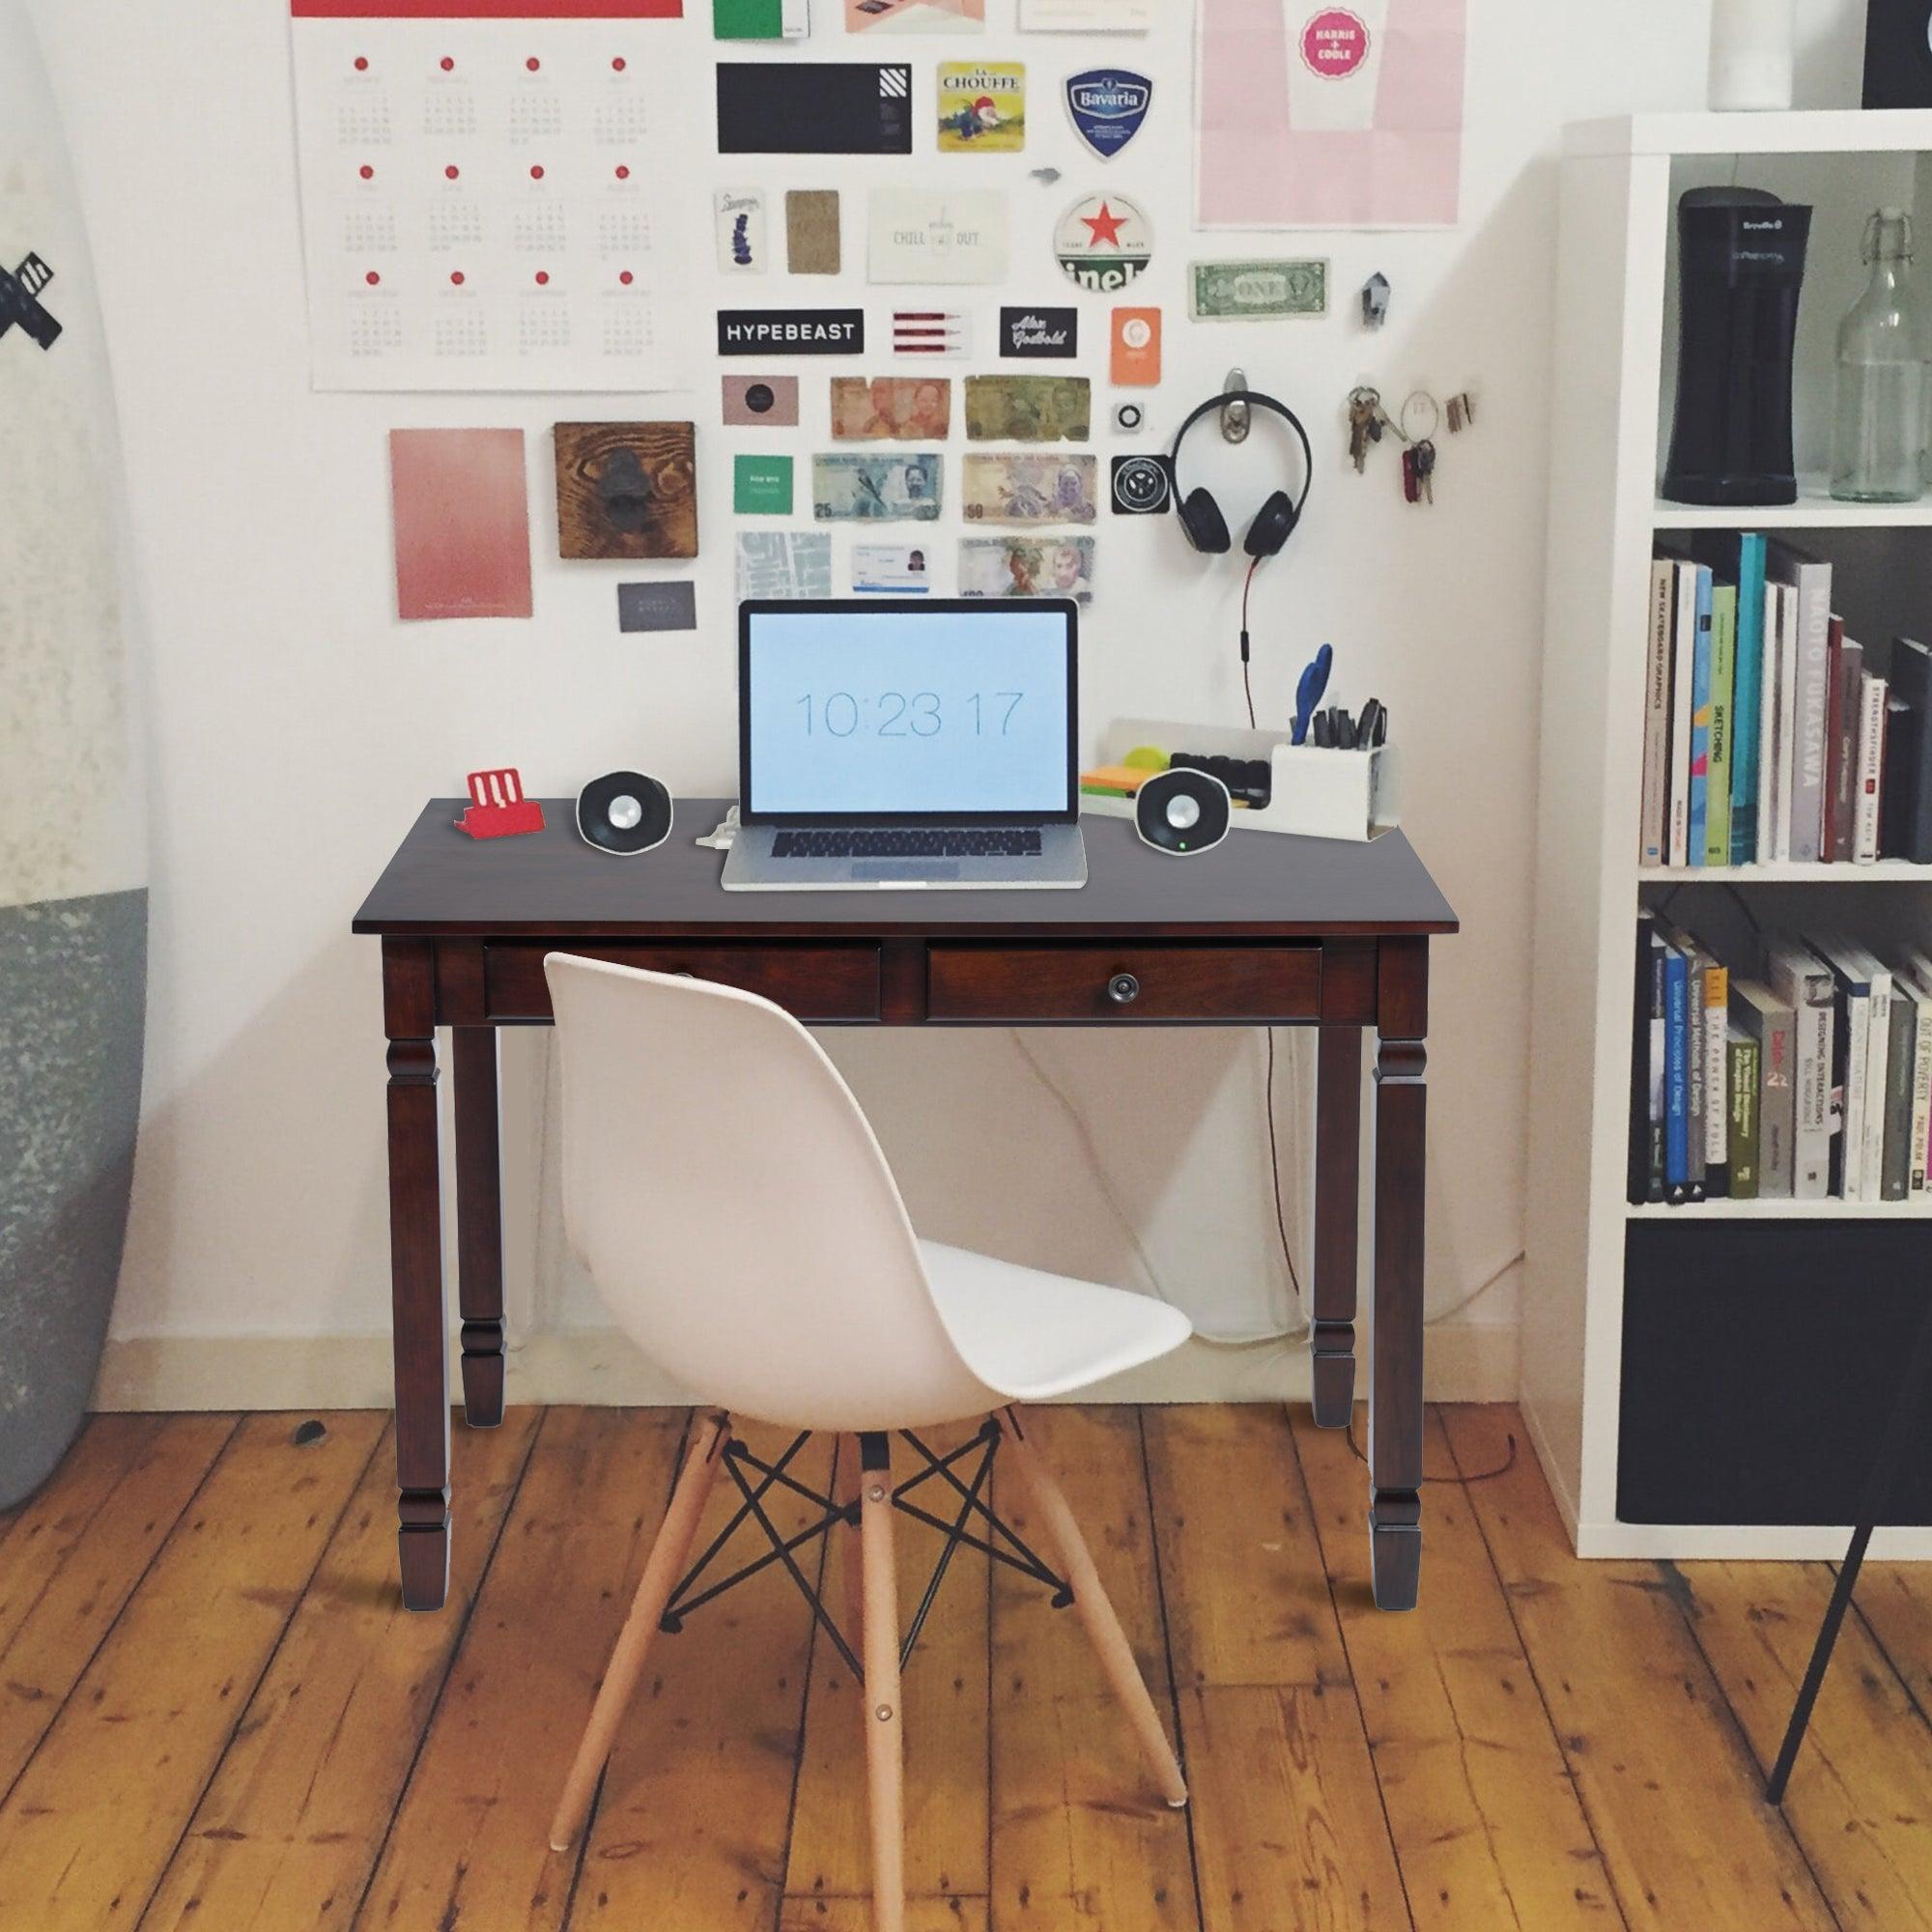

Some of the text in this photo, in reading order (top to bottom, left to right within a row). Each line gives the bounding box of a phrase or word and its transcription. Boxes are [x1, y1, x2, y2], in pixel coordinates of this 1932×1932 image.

[1316, 30, 1355, 41] HARRIS
[1318, 49, 1351, 59] COOLE
[944, 77, 1019, 89] CHOUFFE
[1080, 91, 1138, 106] Bavaria
[893, 231, 980, 245] CHILL OUT
[726, 324, 855, 341] HYPEBEAST
[1659, 579, 1667, 599] NEW
[1654, 663, 1662, 710] GRAPHICS
[1804, 589, 1825, 788] NAOTO FUKASAWA
[797, 692, 1024, 737] 10:23 17
[1713, 705, 1724, 763] SKETCHING
[1671, 980, 1683, 1117] Universal Principles of Design
[1690, 980, 1702, 1117] Universal Methods of Design
[1815, 1011, 1827, 1124] DESIGNING INTERACTIONS
[1767, 1072, 1788, 1087] 22
